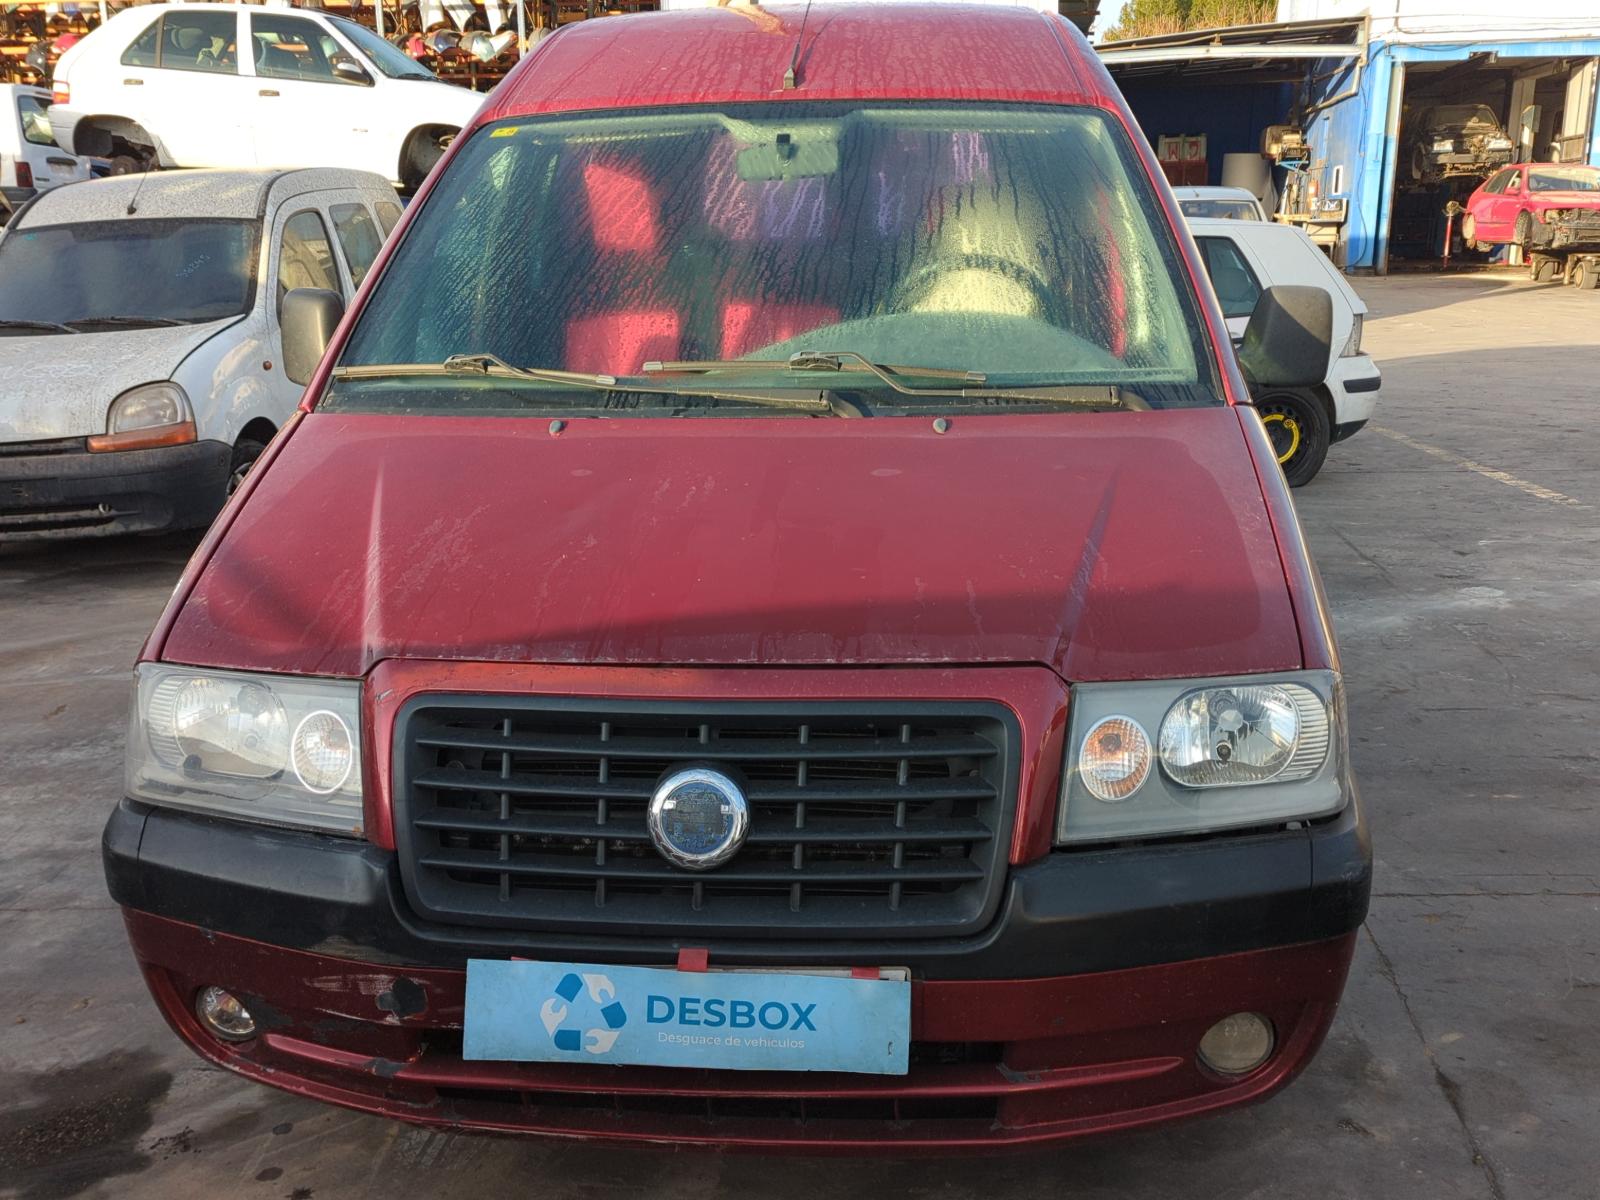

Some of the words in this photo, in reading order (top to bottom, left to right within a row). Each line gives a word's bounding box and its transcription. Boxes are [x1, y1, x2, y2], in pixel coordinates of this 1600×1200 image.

[646, 994, 817, 1032] DESBOX
[658, 1031, 721, 1046] Desguace
[724, 1035, 742, 1047] de
